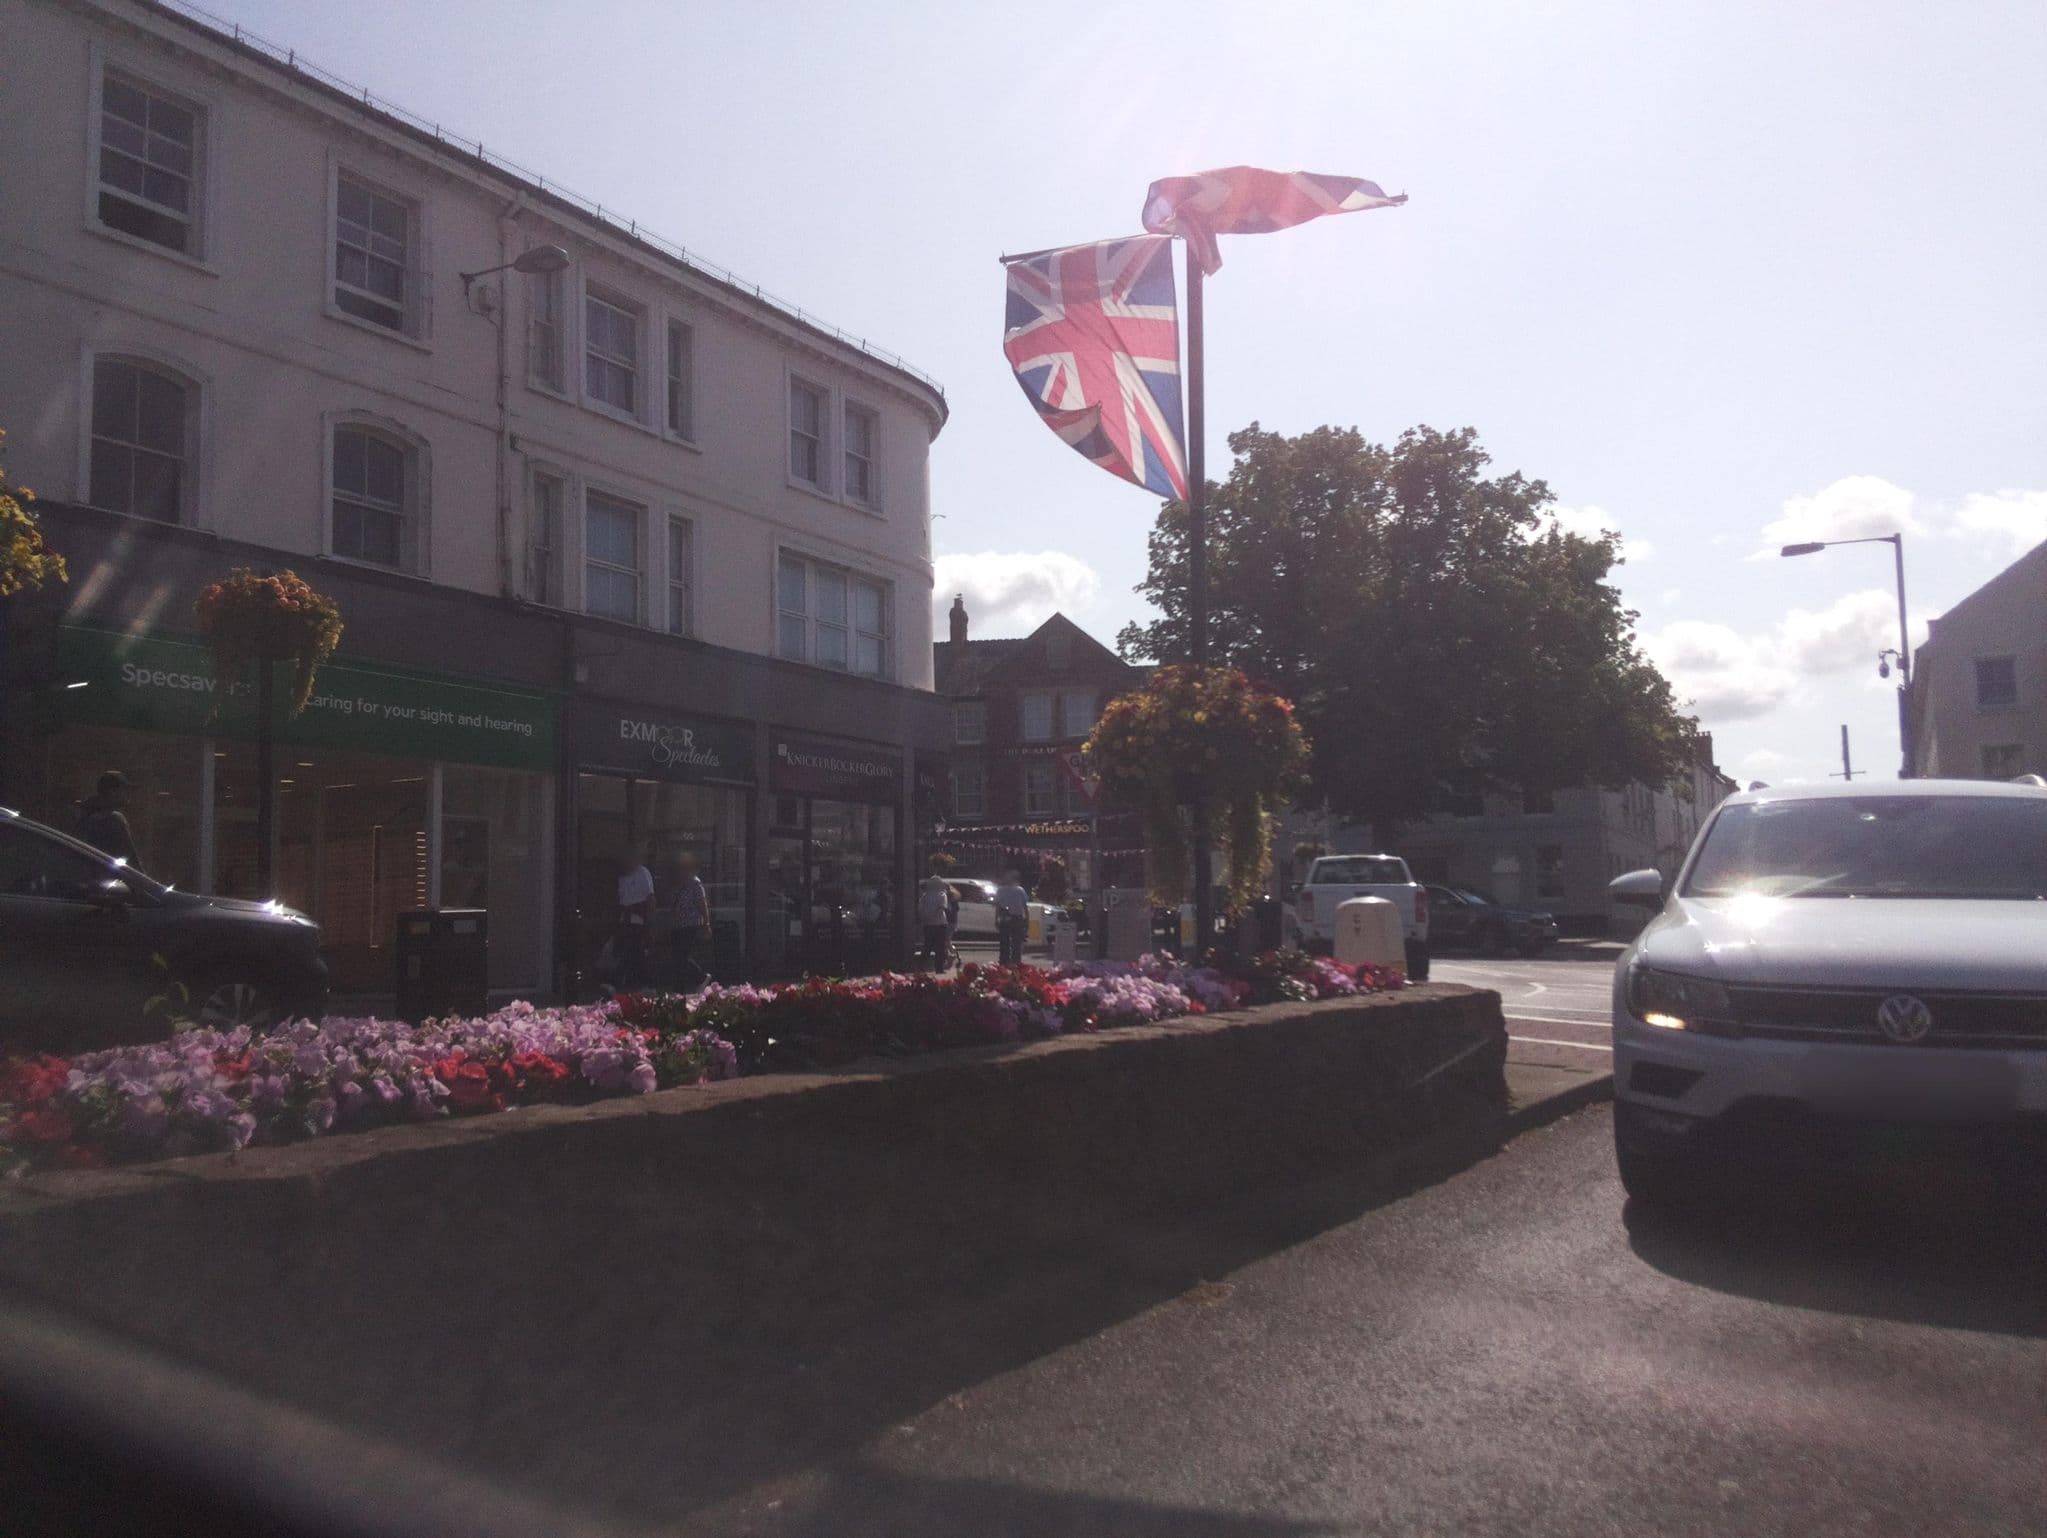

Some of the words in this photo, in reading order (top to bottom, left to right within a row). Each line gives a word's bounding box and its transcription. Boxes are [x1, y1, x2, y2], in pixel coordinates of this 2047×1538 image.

[121, 662, 251, 696] Specsavr
[356, 698, 379, 713] for
[383, 704, 416, 720] your
[419, 707, 454, 725] sight
[456, 713, 482, 728] and
[485, 716, 533, 737] hearing
[1024, 824, 1090, 834] WETHERSPOO
